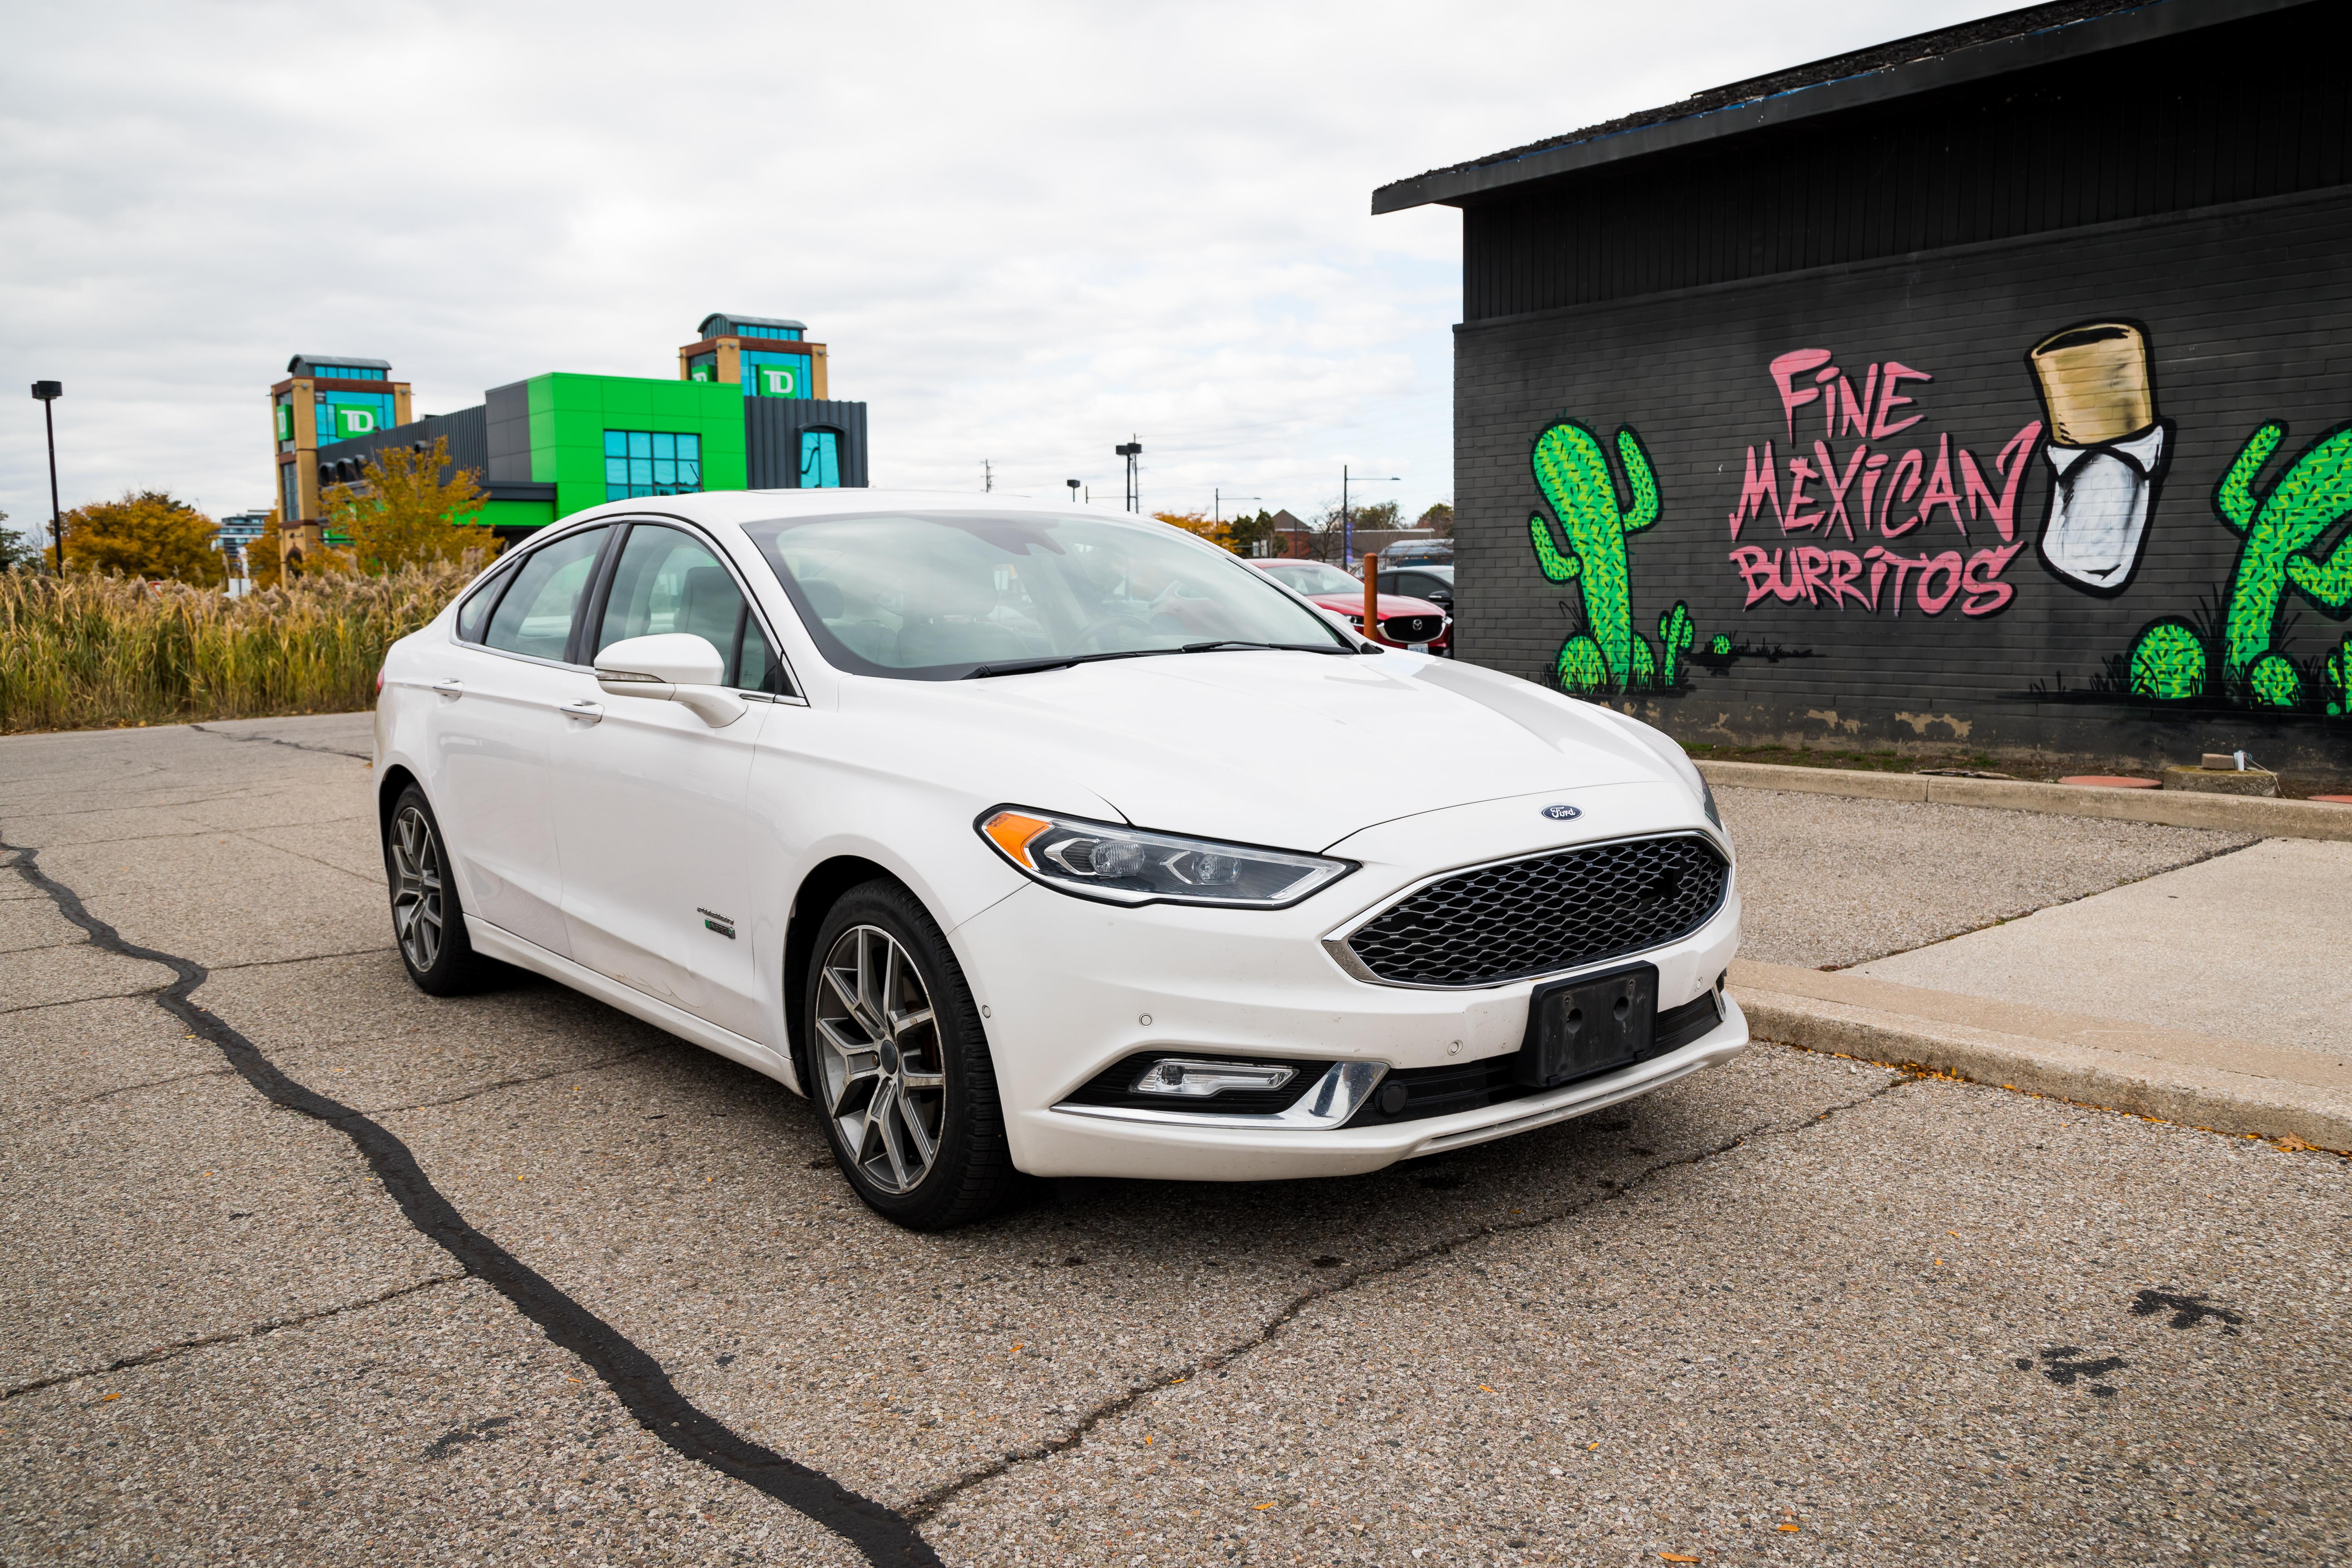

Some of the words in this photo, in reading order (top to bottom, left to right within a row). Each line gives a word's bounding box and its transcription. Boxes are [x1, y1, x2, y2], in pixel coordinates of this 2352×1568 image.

[763, 370, 794, 393] TD
[340, 410, 374, 432] TD
[1550, 806, 1576, 818] Ford
